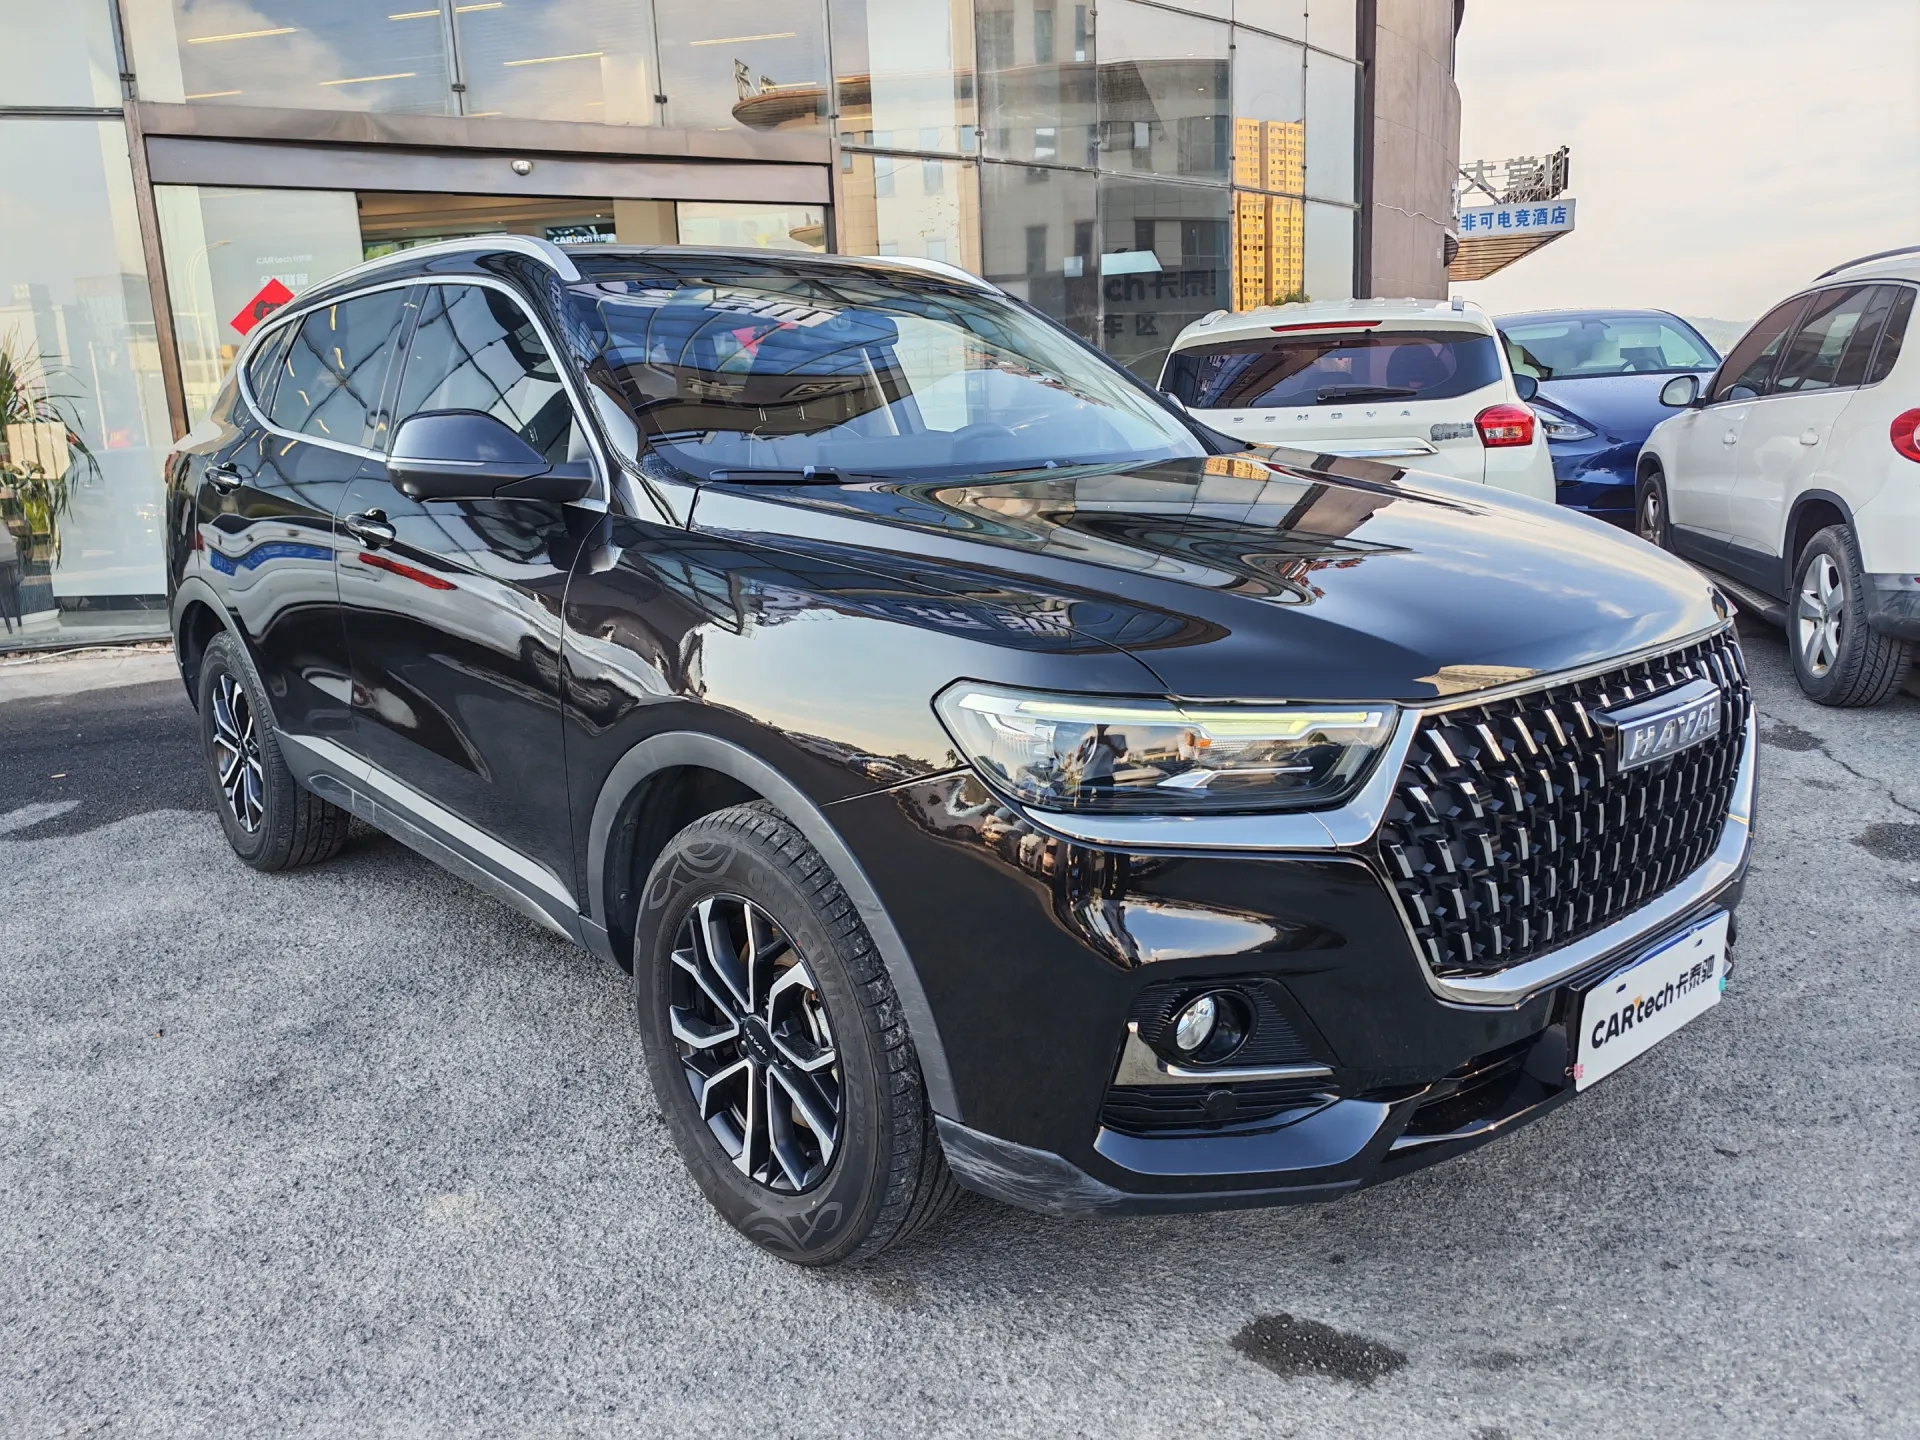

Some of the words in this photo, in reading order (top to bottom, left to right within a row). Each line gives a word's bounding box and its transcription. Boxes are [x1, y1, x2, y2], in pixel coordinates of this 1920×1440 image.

[1461, 205, 1567, 231] 非可电竞酒店
[1629, 702, 1720, 760] HAVAL
[1591, 981, 1674, 1049] CARtech
[745, 1027, 768, 1056] HAVAL
